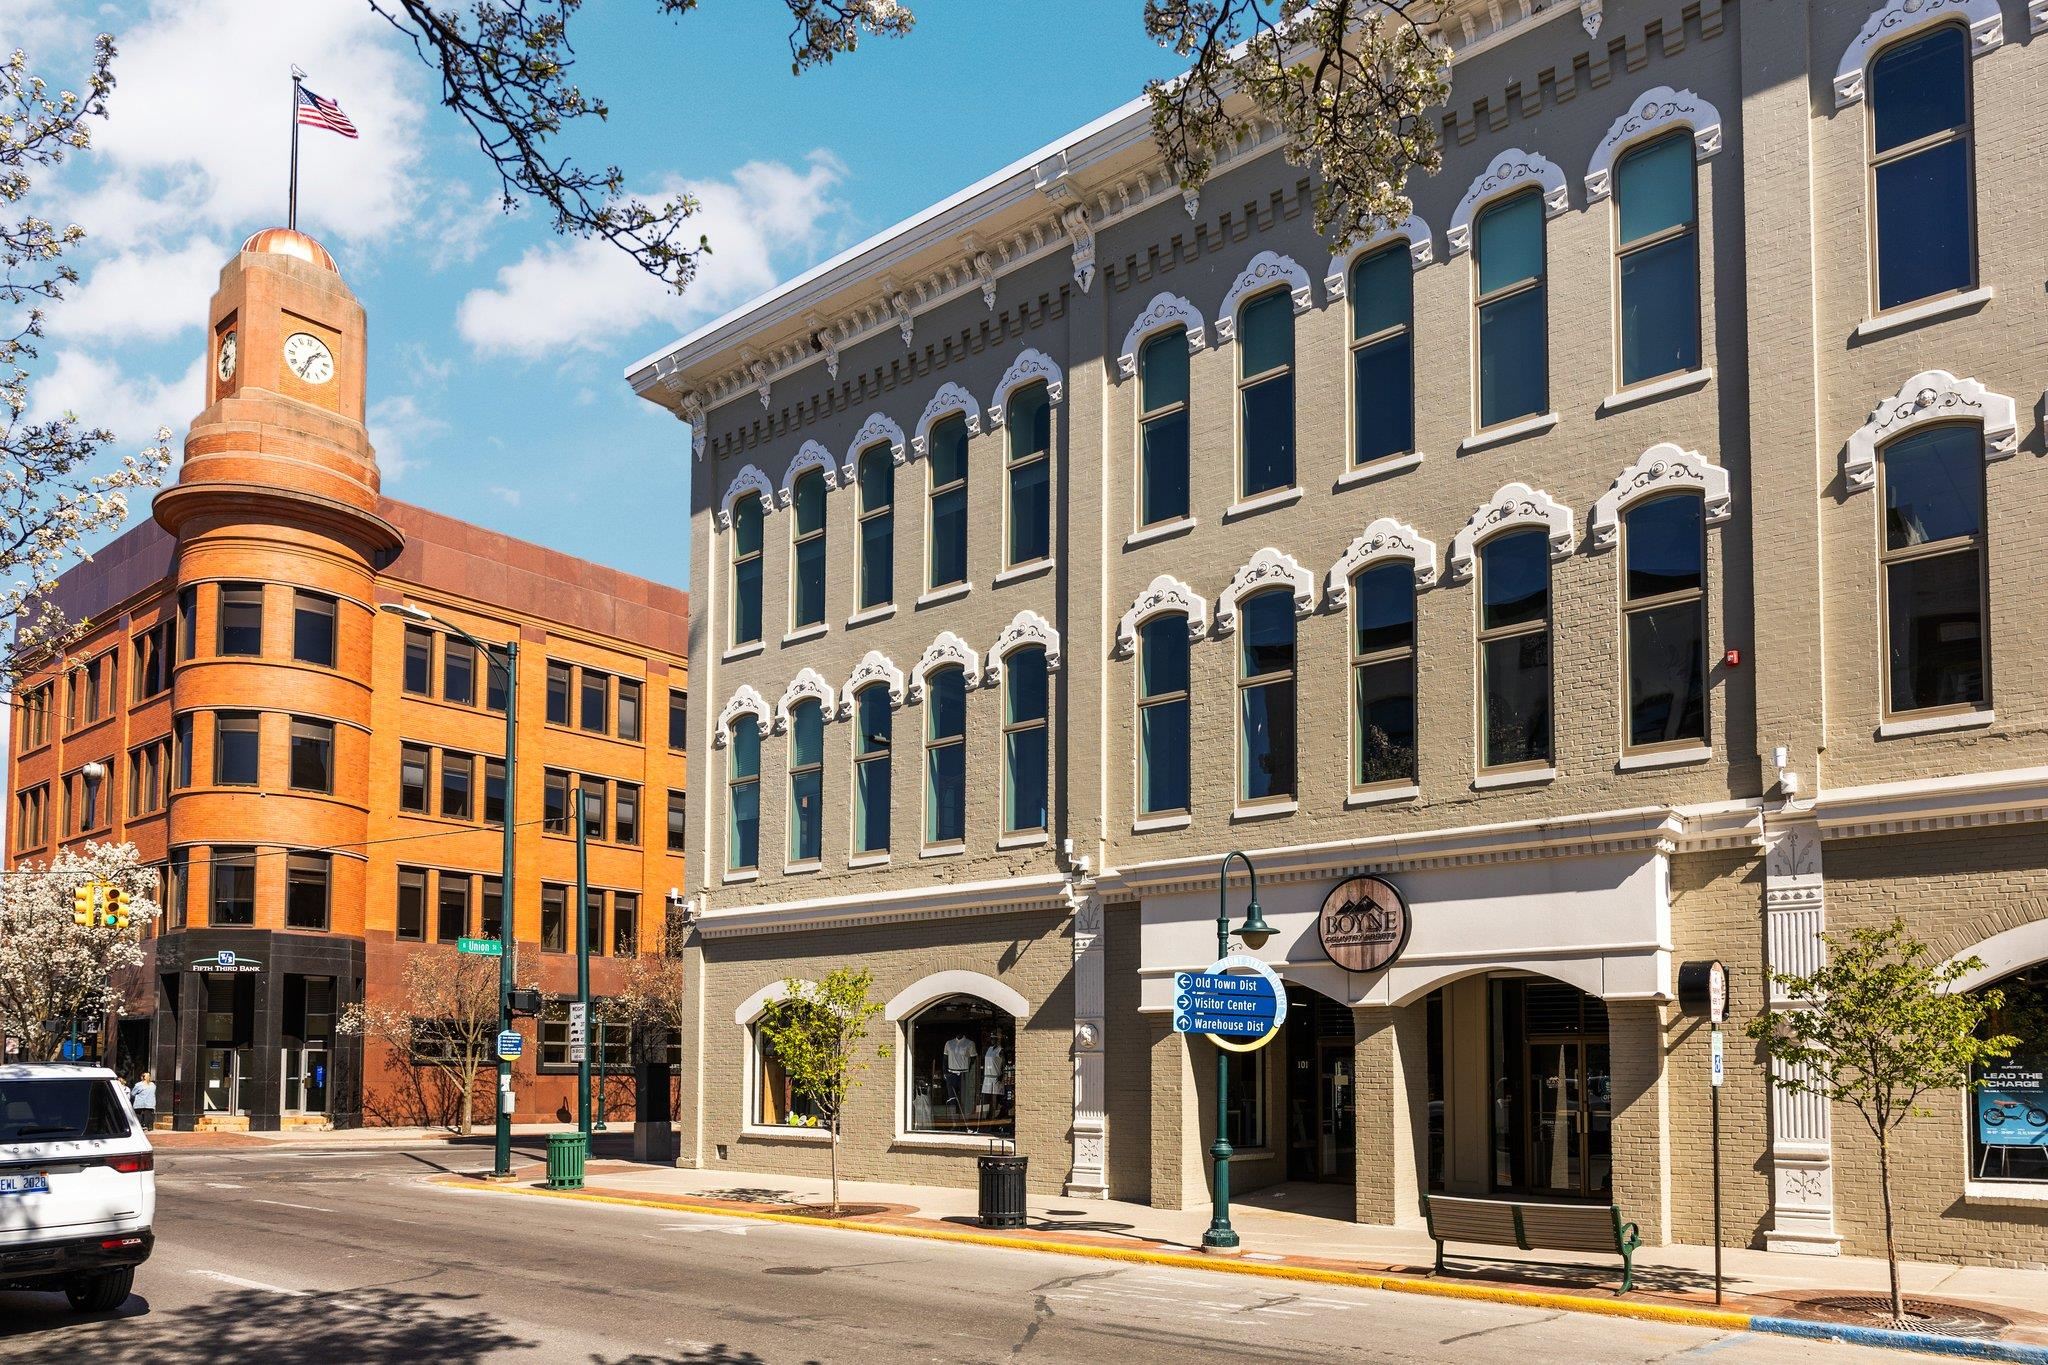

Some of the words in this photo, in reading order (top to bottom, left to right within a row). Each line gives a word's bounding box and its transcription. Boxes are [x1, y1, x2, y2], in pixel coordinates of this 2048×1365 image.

[1326, 911, 1397, 935] BOYNE
[469, 941, 490, 952] Union
[1195, 978, 1210, 989] Old
[1214, 978, 1236, 990] Town
[1240, 980, 1257, 991] Dist
[1195, 998, 1224, 1010] Visitor
[1227, 1000, 1257, 1011] Center
[1194, 1018, 1244, 1031] Warehouse
[1247, 1020, 1264, 1032] Dist
[1983, 1072, 2017, 1080] LEAD
[2018, 1072, 2043, 1080] THE
[1987, 1080, 2040, 1088] CHARGE
[23, 1176, 46, 1190] 2028
